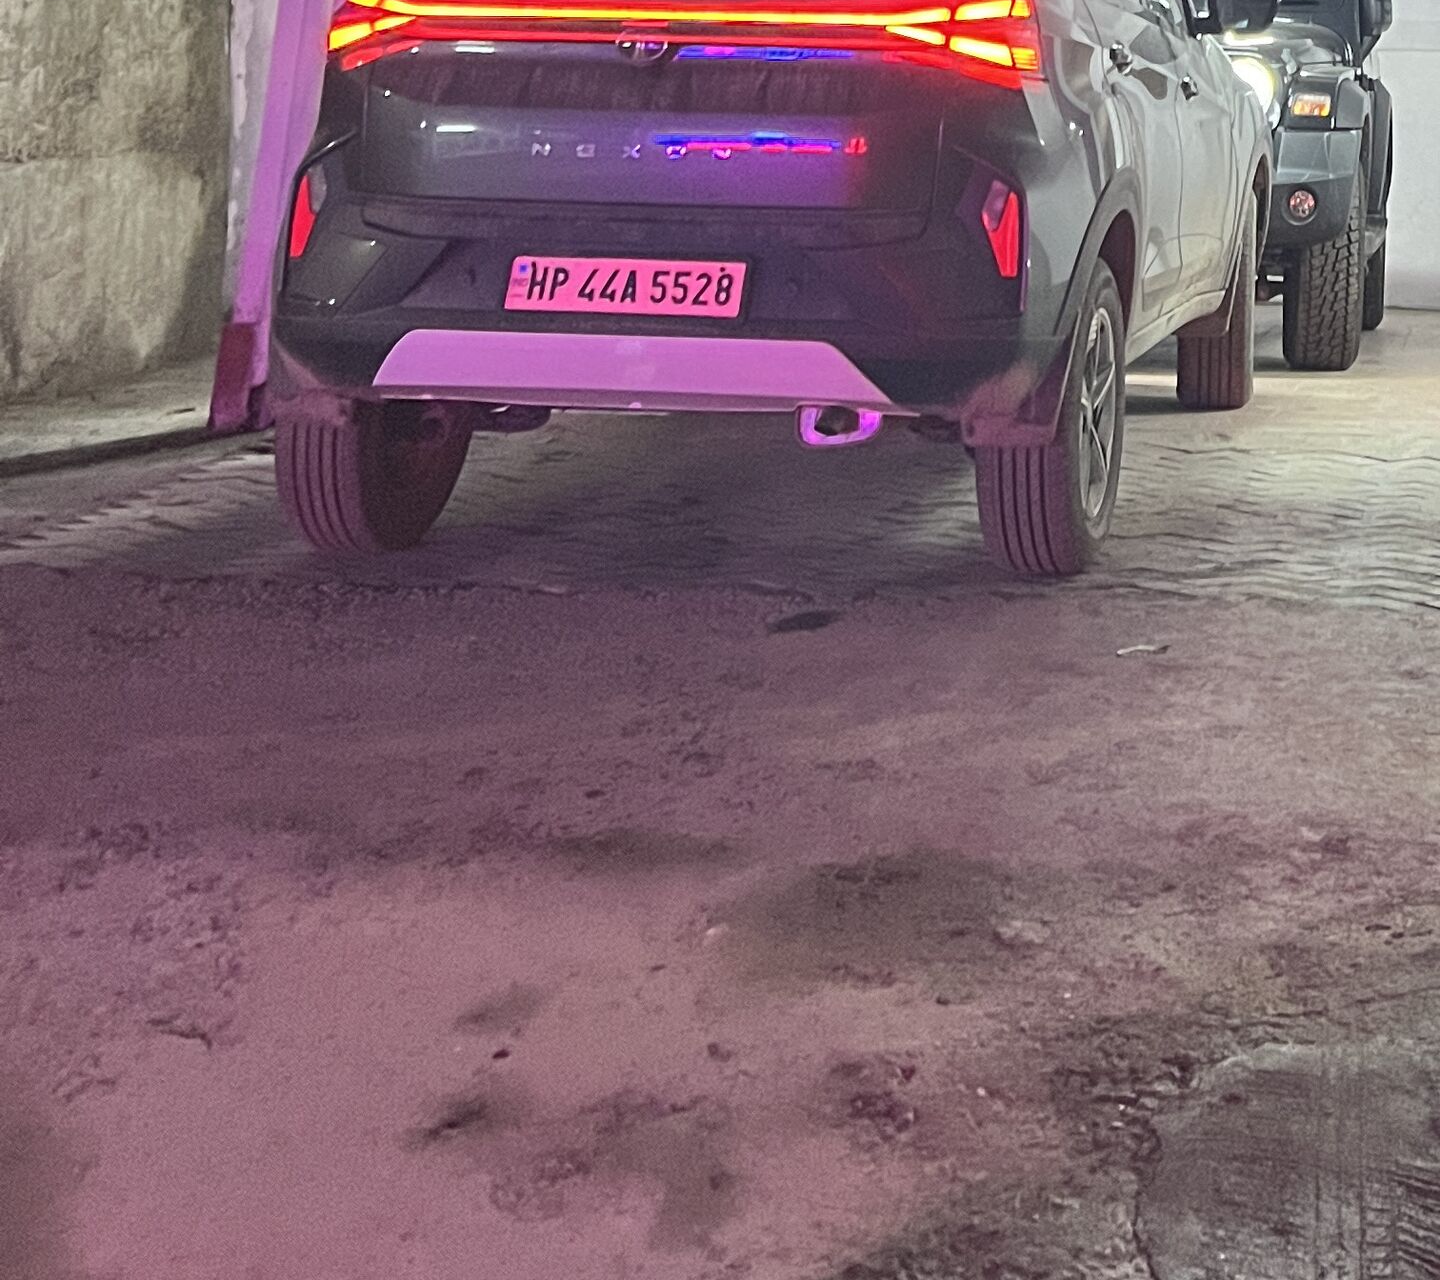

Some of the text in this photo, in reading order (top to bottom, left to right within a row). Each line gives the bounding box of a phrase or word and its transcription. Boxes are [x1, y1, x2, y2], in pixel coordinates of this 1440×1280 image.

[527, 262, 734, 306] HP 44A 5528
